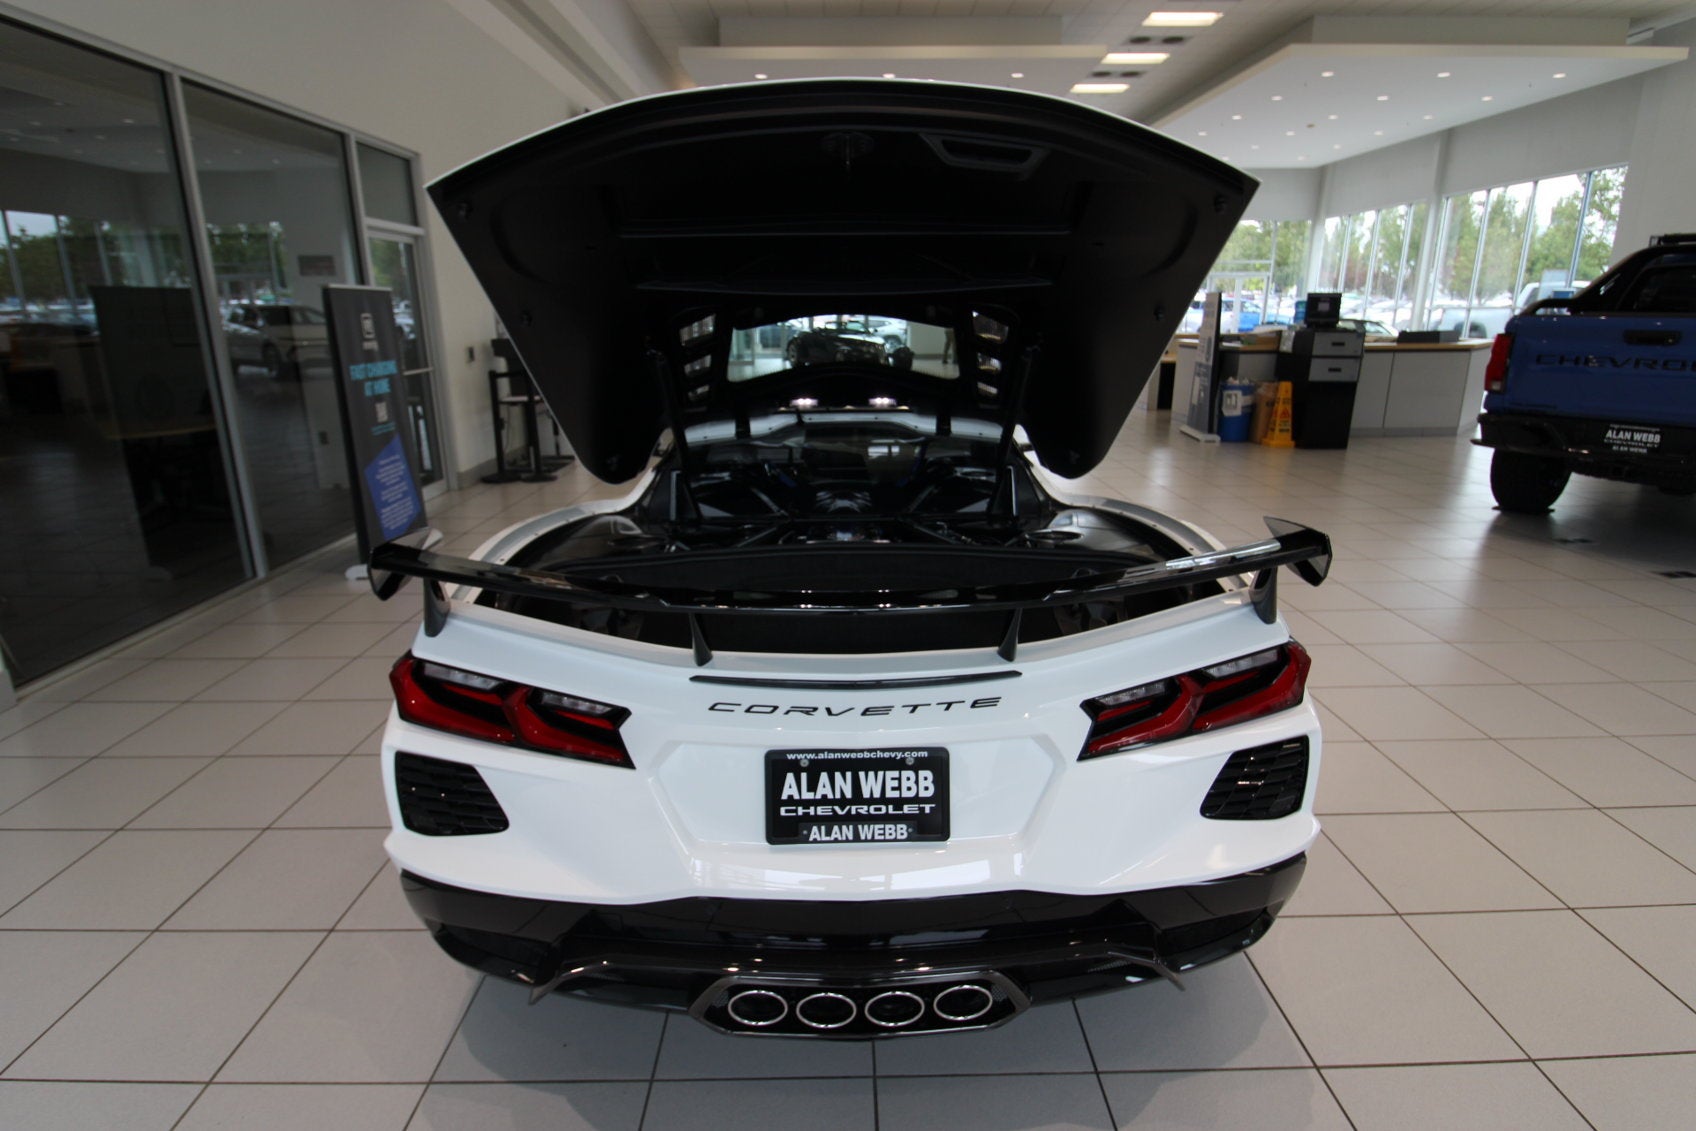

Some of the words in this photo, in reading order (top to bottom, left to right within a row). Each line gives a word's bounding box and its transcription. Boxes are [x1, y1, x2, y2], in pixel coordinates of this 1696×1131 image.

[1535, 353, 1696, 372] CHEVRO
[1605, 429, 1631, 440] ALAN
[1633, 431, 1661, 443] WEBB
[708, 696, 1002, 717] CORVETTE
[786, 750, 928, 760] www.alanwebbchevy.com
[781, 771, 852, 800] ALAN
[858, 769, 935, 798] WEBB
[780, 804, 936, 816] CHEVROLET
[809, 825, 853, 841] ALAN
[857, 824, 907, 840] WEBB
